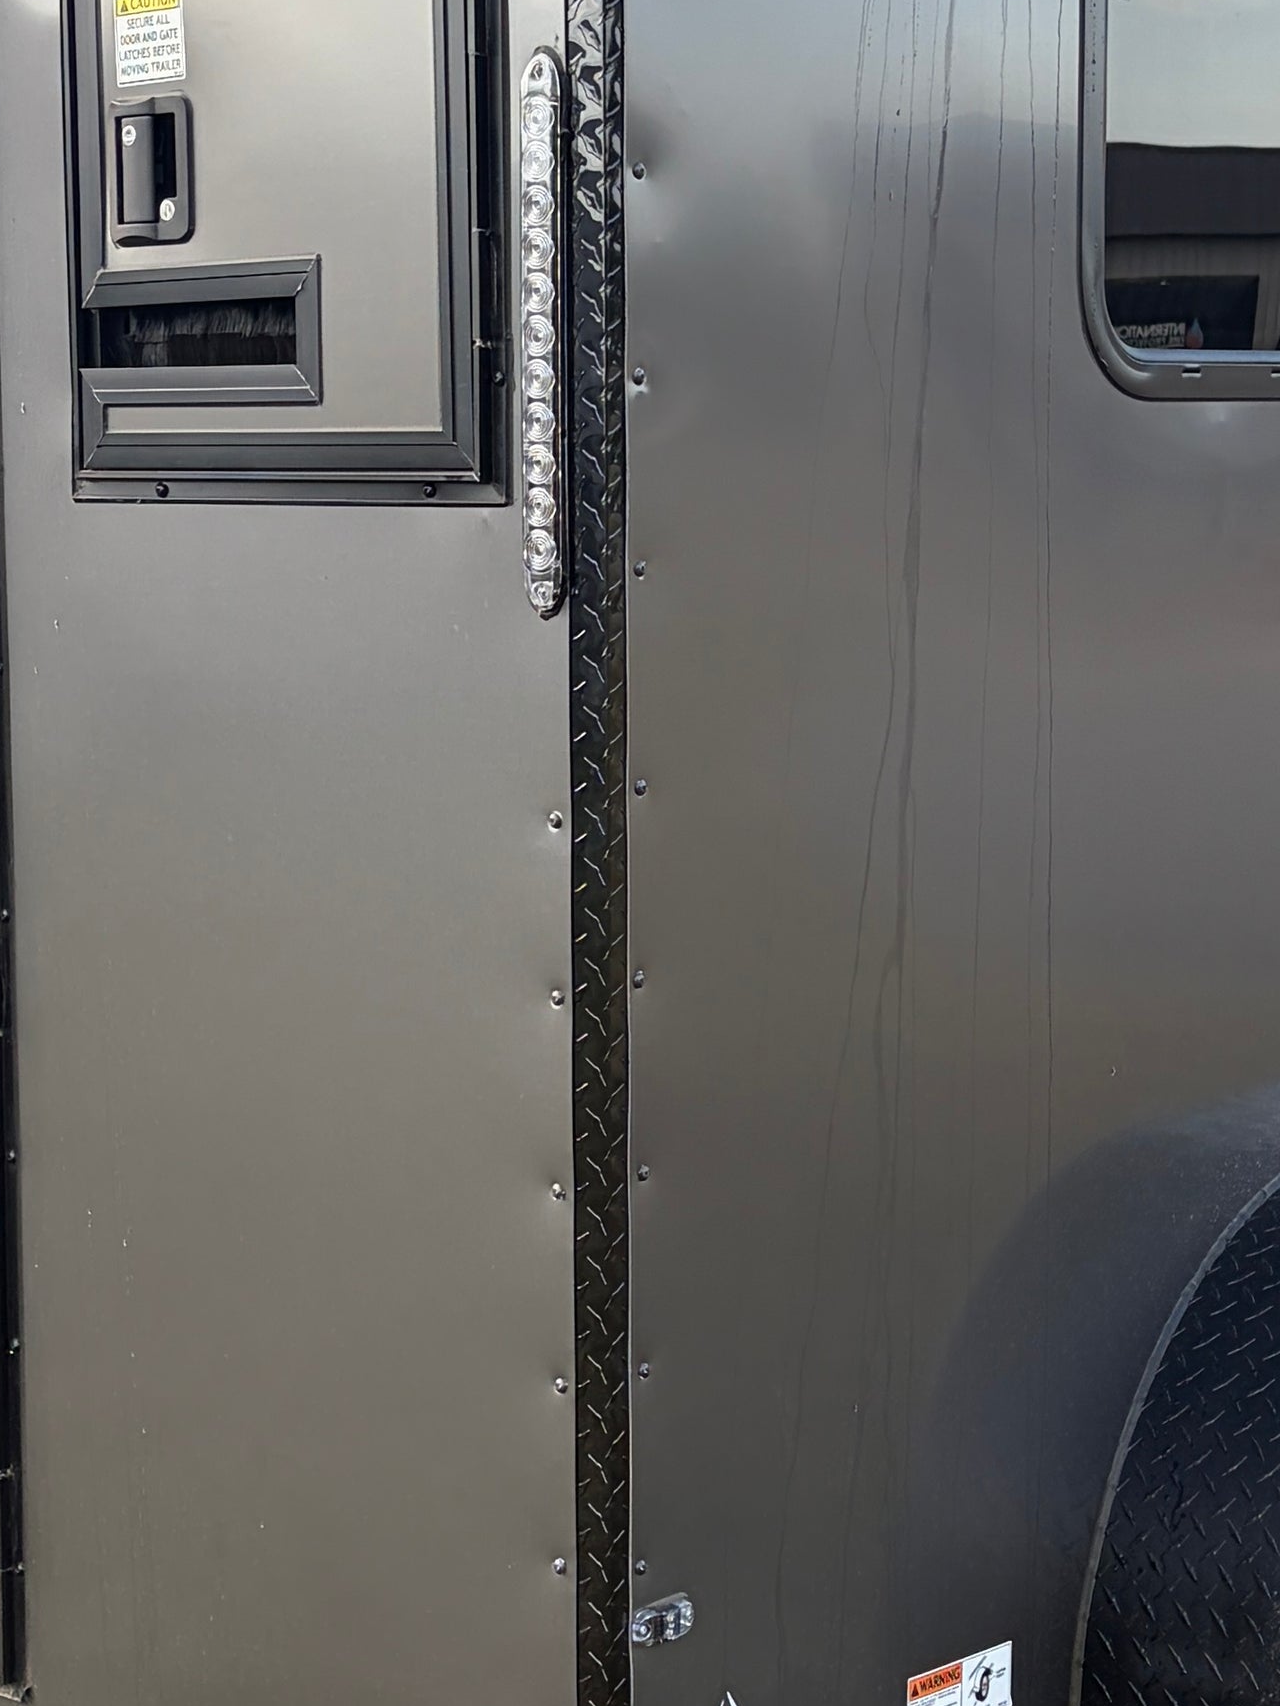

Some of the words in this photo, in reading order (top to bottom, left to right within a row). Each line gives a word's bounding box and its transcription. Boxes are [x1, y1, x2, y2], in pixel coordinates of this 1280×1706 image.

[127, 15, 154, 30] SECURE
[156, 14, 170, 26] ALL
[120, 33, 141, 46] DOOR
[142, 31, 158, 43] AND
[159, 28, 179, 41] GATE
[119, 46, 151, 61] LATCHES
[153, 43, 181, 57] BEFORE
[121, 63, 150, 77] MOVING
[151, 58, 181, 72] TRAILER
[919, 1666, 961, 1692] WARNING
